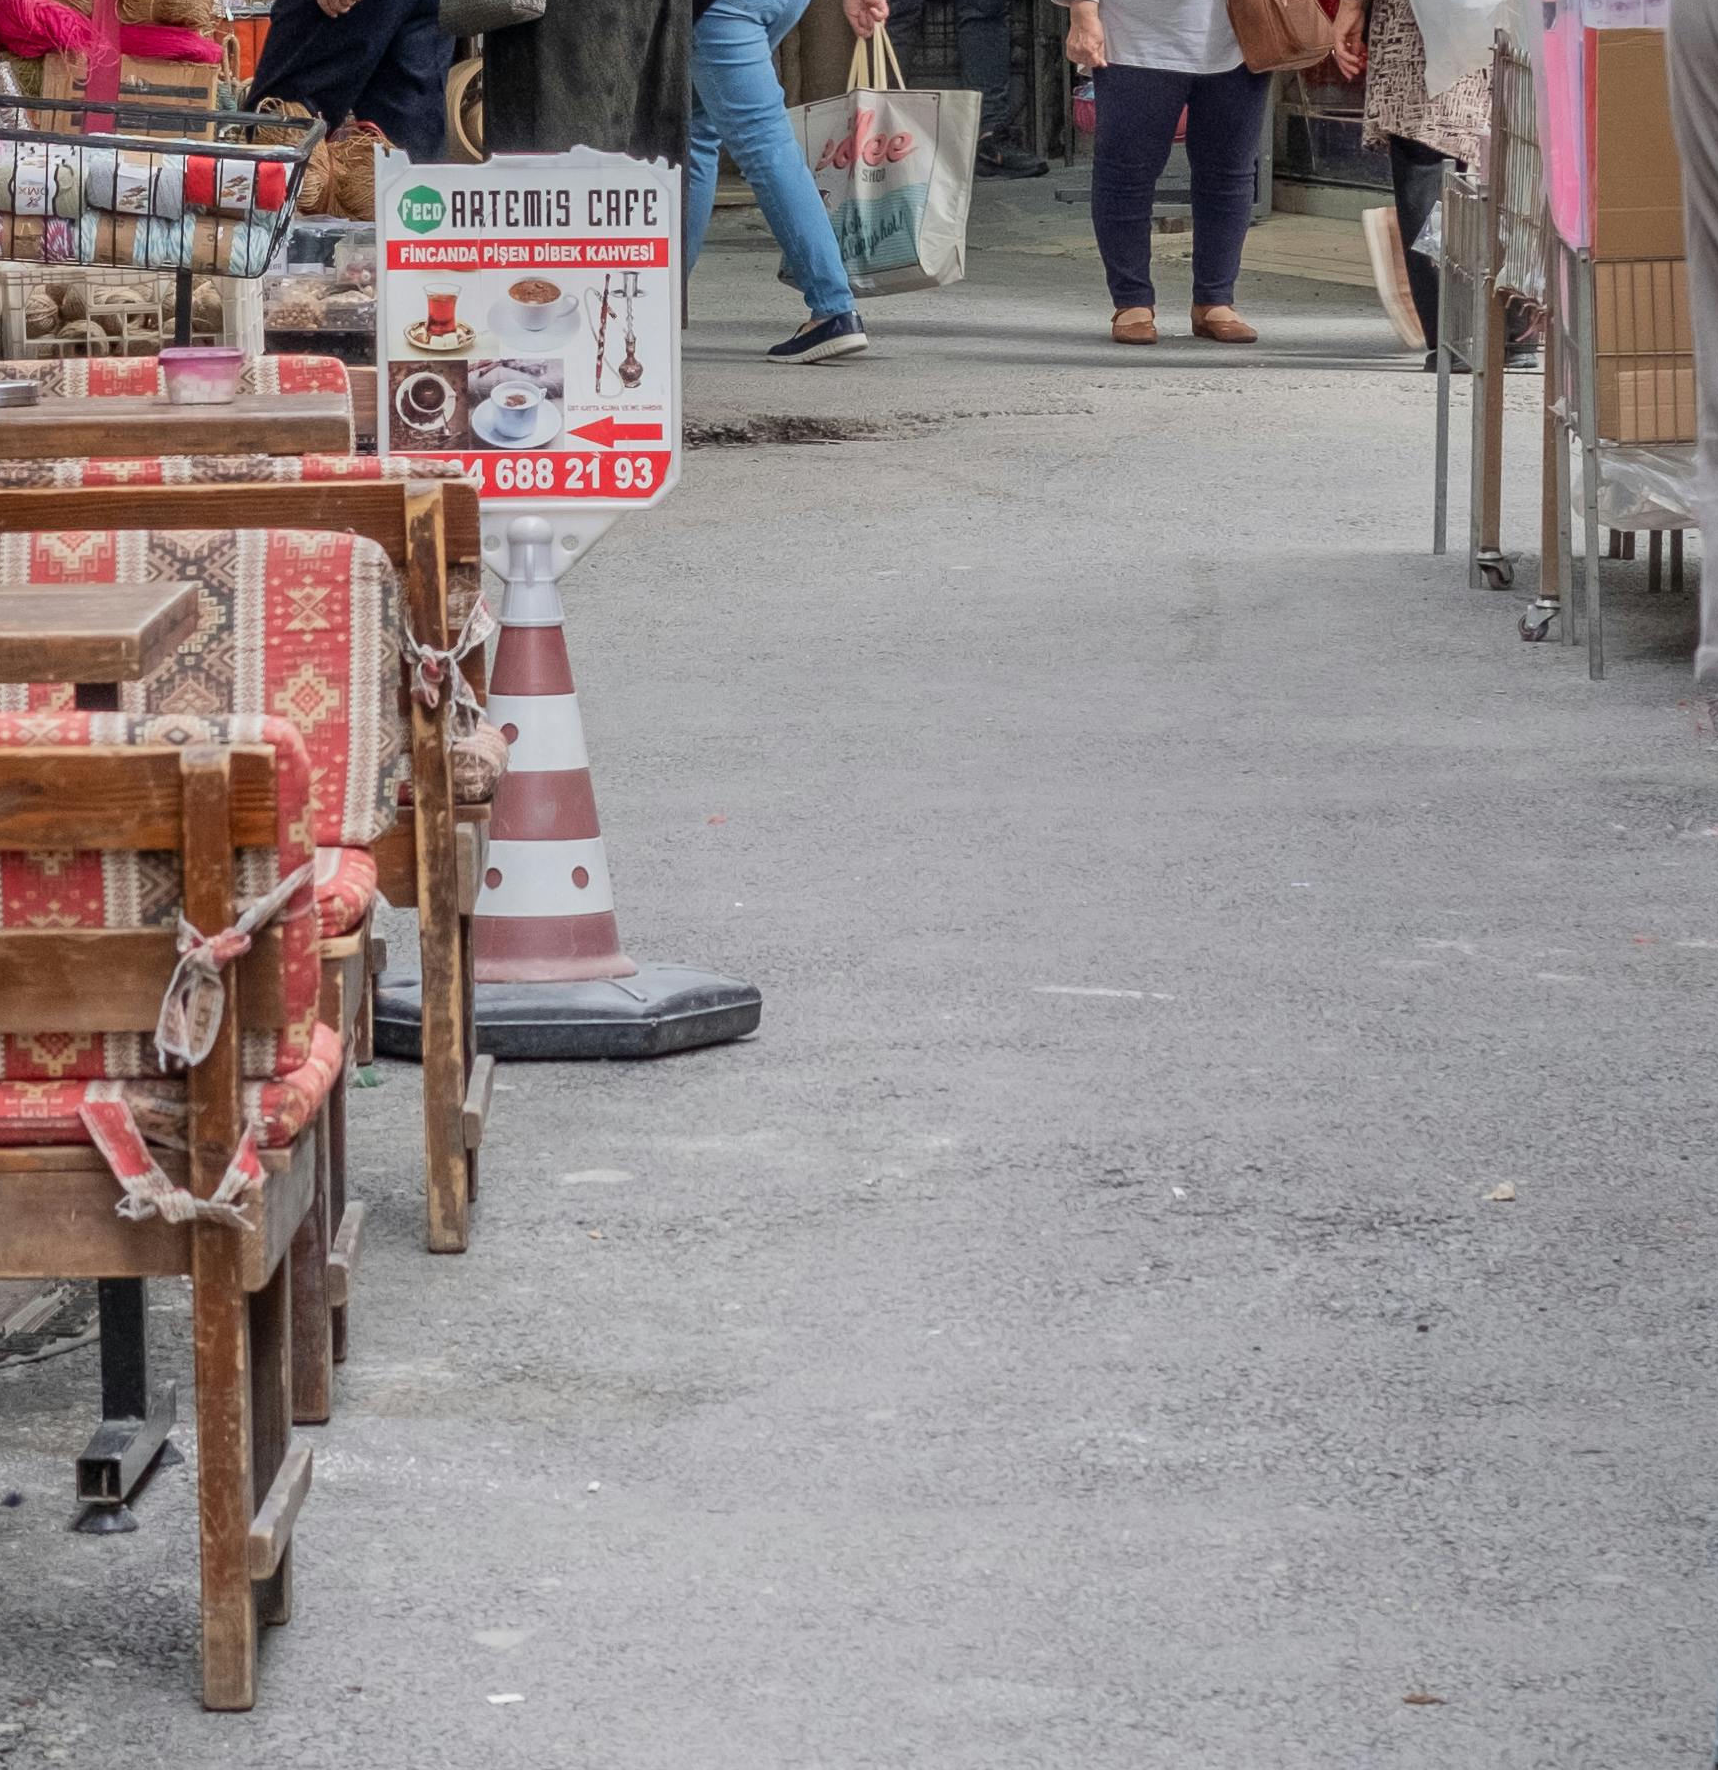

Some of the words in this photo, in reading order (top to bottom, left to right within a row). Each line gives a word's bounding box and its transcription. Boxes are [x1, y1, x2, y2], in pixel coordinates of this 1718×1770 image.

[588, 188, 659, 227] CAFE
[400, 242, 480, 264] FİNCANDA
[483, 242, 531, 267] PİŞEN
[534, 241, 582, 263] DİBEK
[586, 241, 655, 262] KAHVESİ
[494, 458, 555, 491] 688
[564, 456, 602, 490] 21
[614, 457, 654, 490] 93
